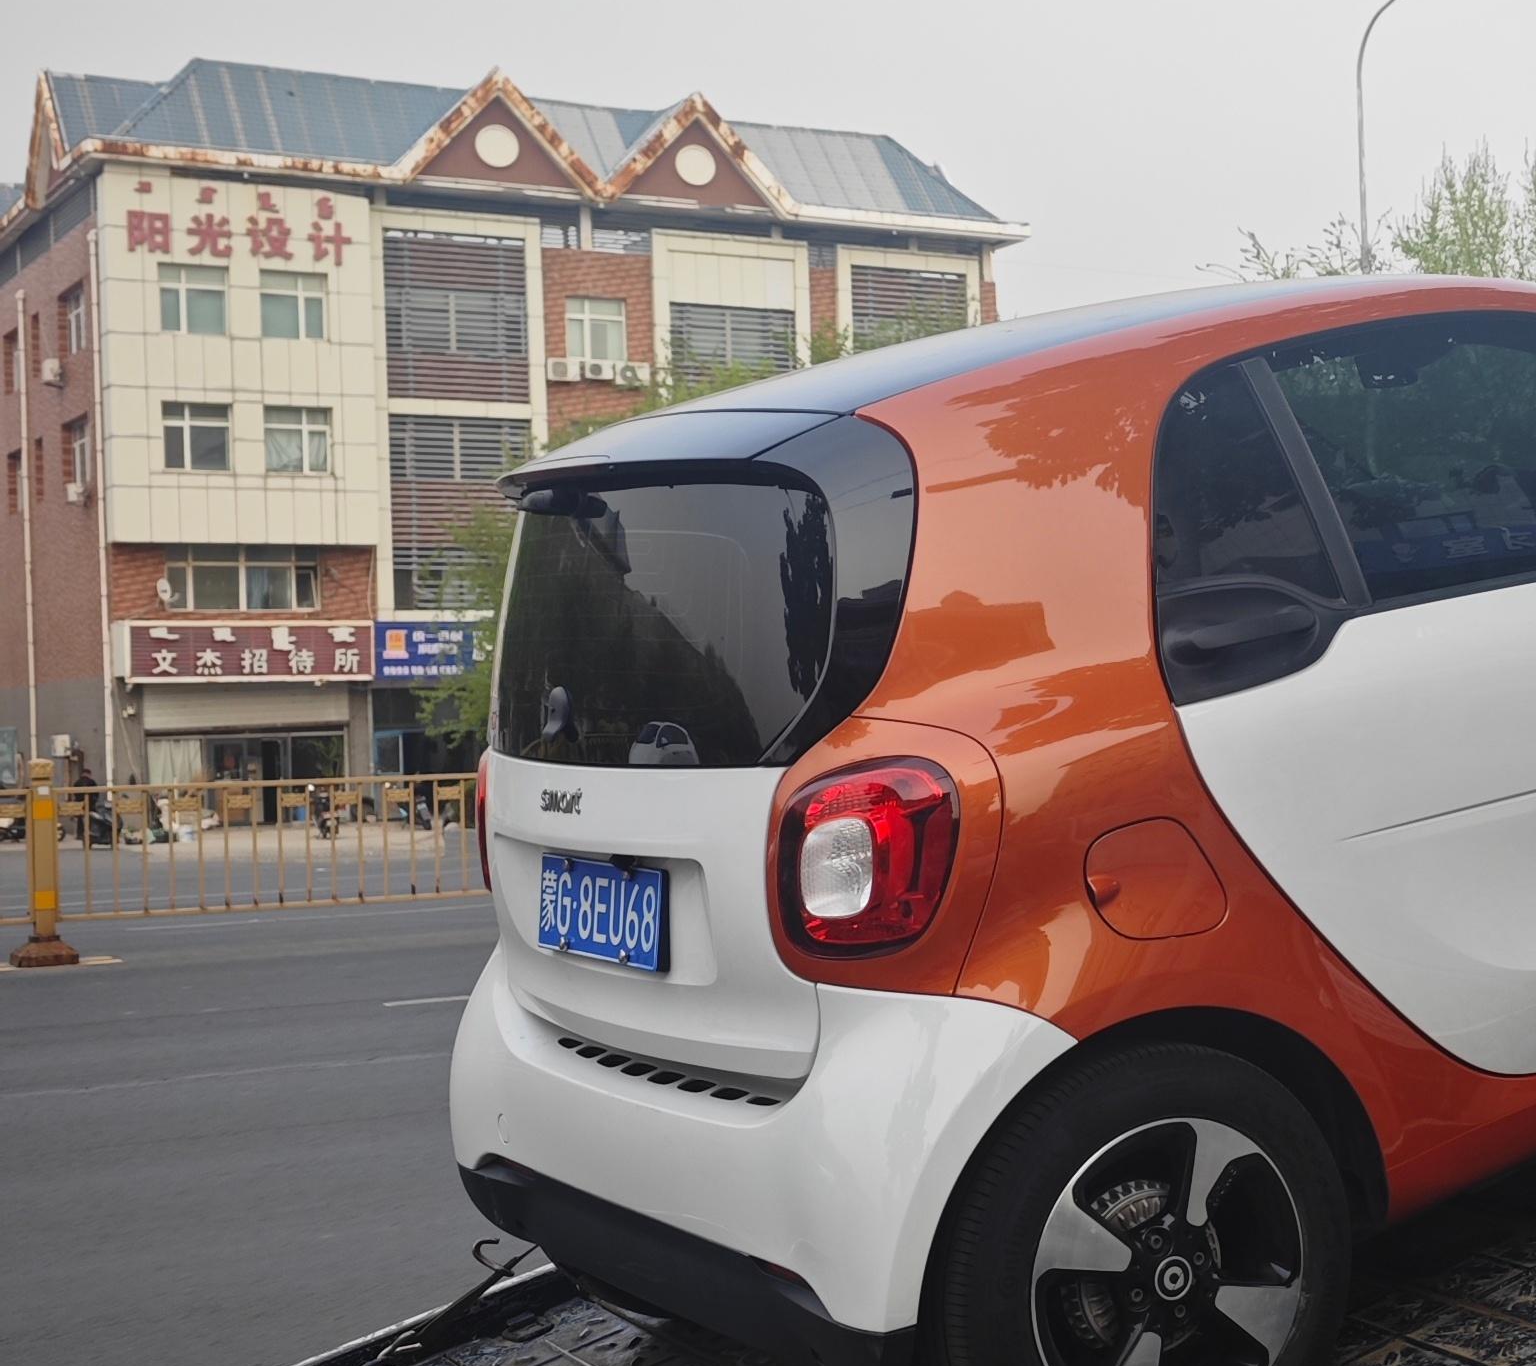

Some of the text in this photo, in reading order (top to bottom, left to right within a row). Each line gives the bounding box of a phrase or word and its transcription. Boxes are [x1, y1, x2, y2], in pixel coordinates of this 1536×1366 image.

[126, 210, 353, 267] 阳光设计
[151, 648, 361, 675] 文杰招待所
[540, 788, 583, 815] smart
